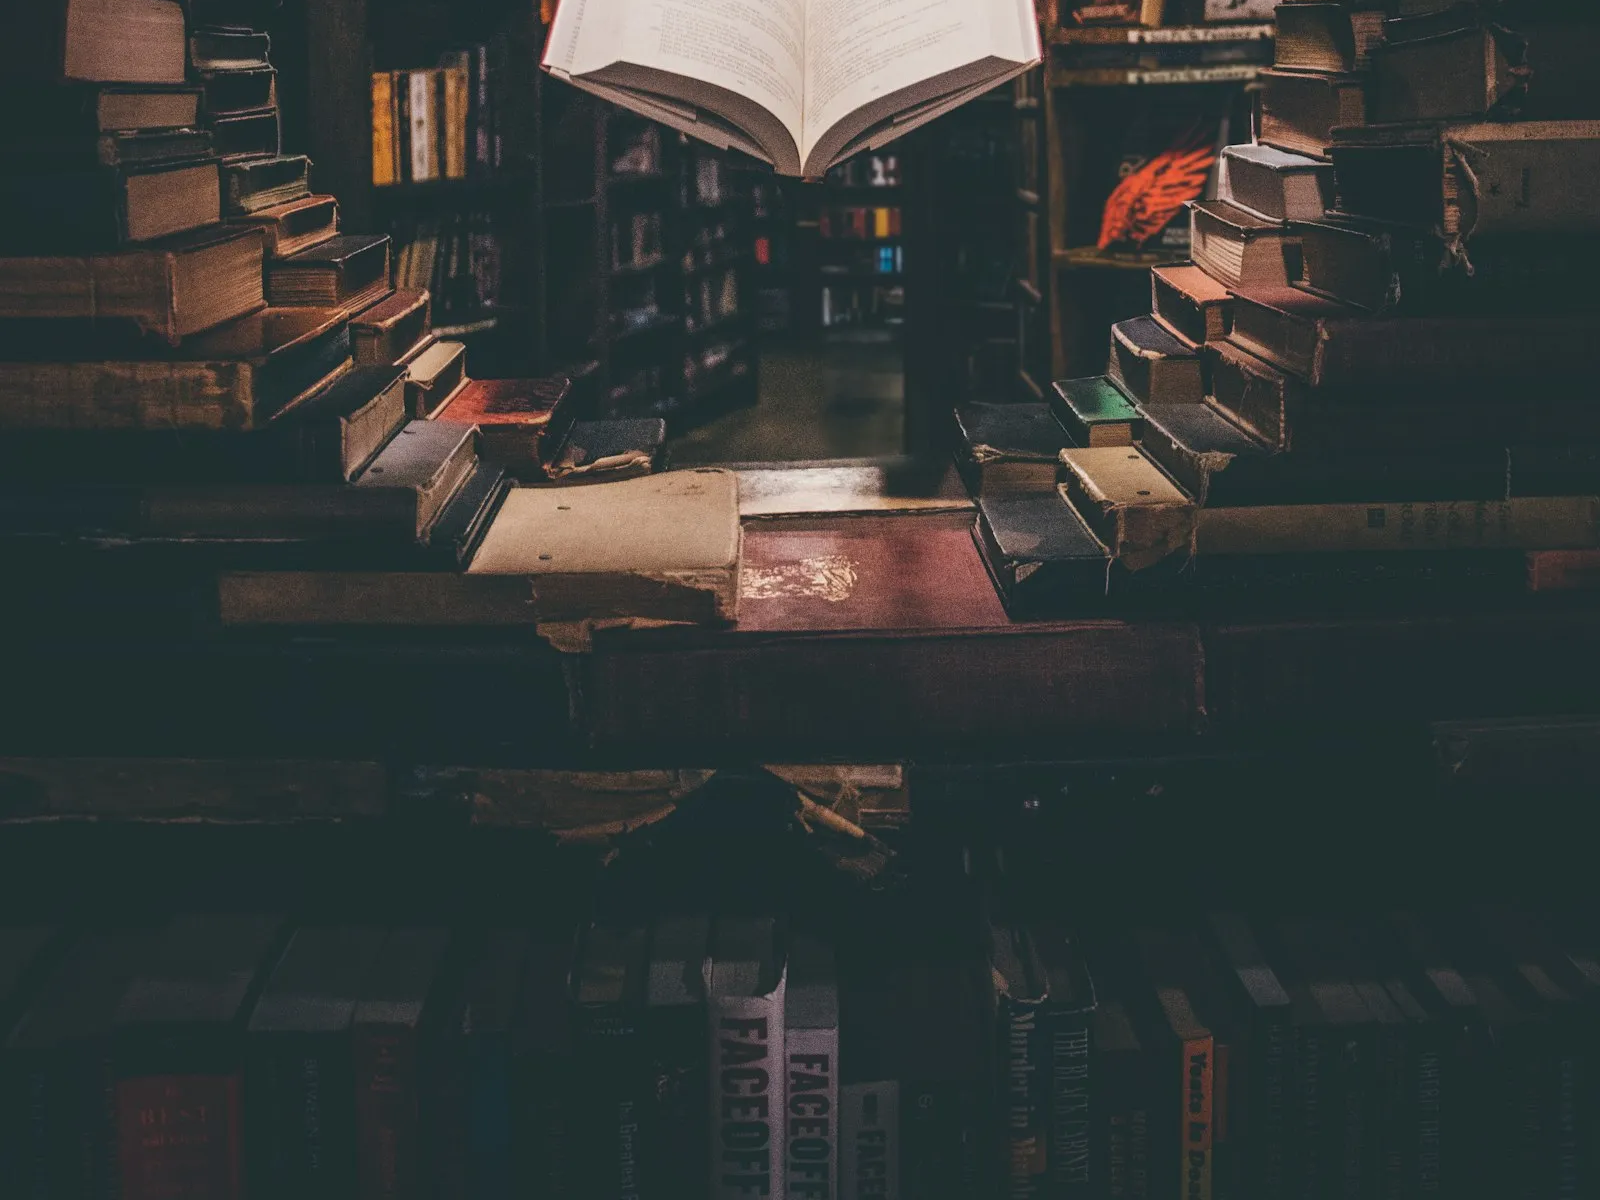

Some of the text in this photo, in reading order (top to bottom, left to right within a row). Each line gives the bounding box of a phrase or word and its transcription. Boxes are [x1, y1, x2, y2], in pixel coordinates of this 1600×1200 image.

[1010, 1011, 1037, 1097] Murder
[1189, 1052, 1206, 1112] Yeats
[721, 1016, 770, 1196] FACEOFF
[789, 1054, 830, 1200] FACEOFF
[1011, 1105, 1035, 1128] in
[1053, 1027, 1089, 1184] THE BLACK CABINET
[618, 1122, 639, 1190] Greatest
